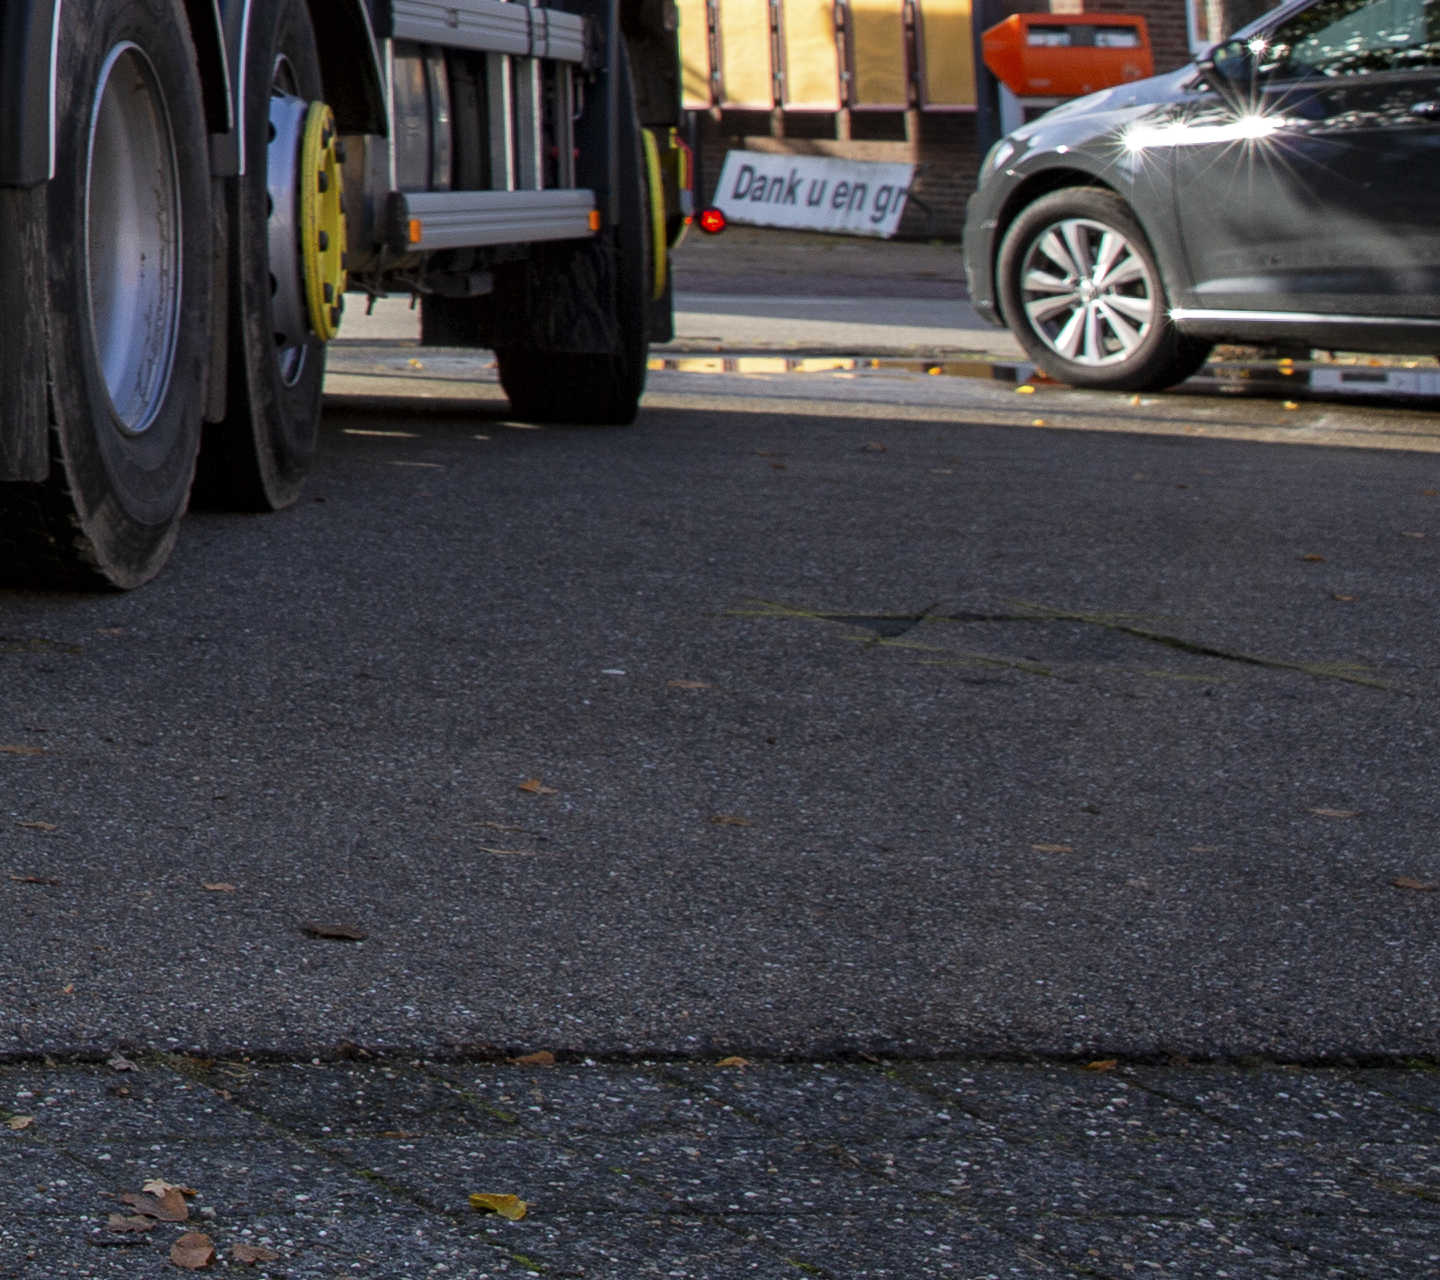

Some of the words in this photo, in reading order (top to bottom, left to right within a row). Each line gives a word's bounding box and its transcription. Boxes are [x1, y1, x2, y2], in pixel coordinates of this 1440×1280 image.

[732, 164, 804, 205] Dank
[806, 180, 829, 207] u
[831, 180, 869, 212] en
